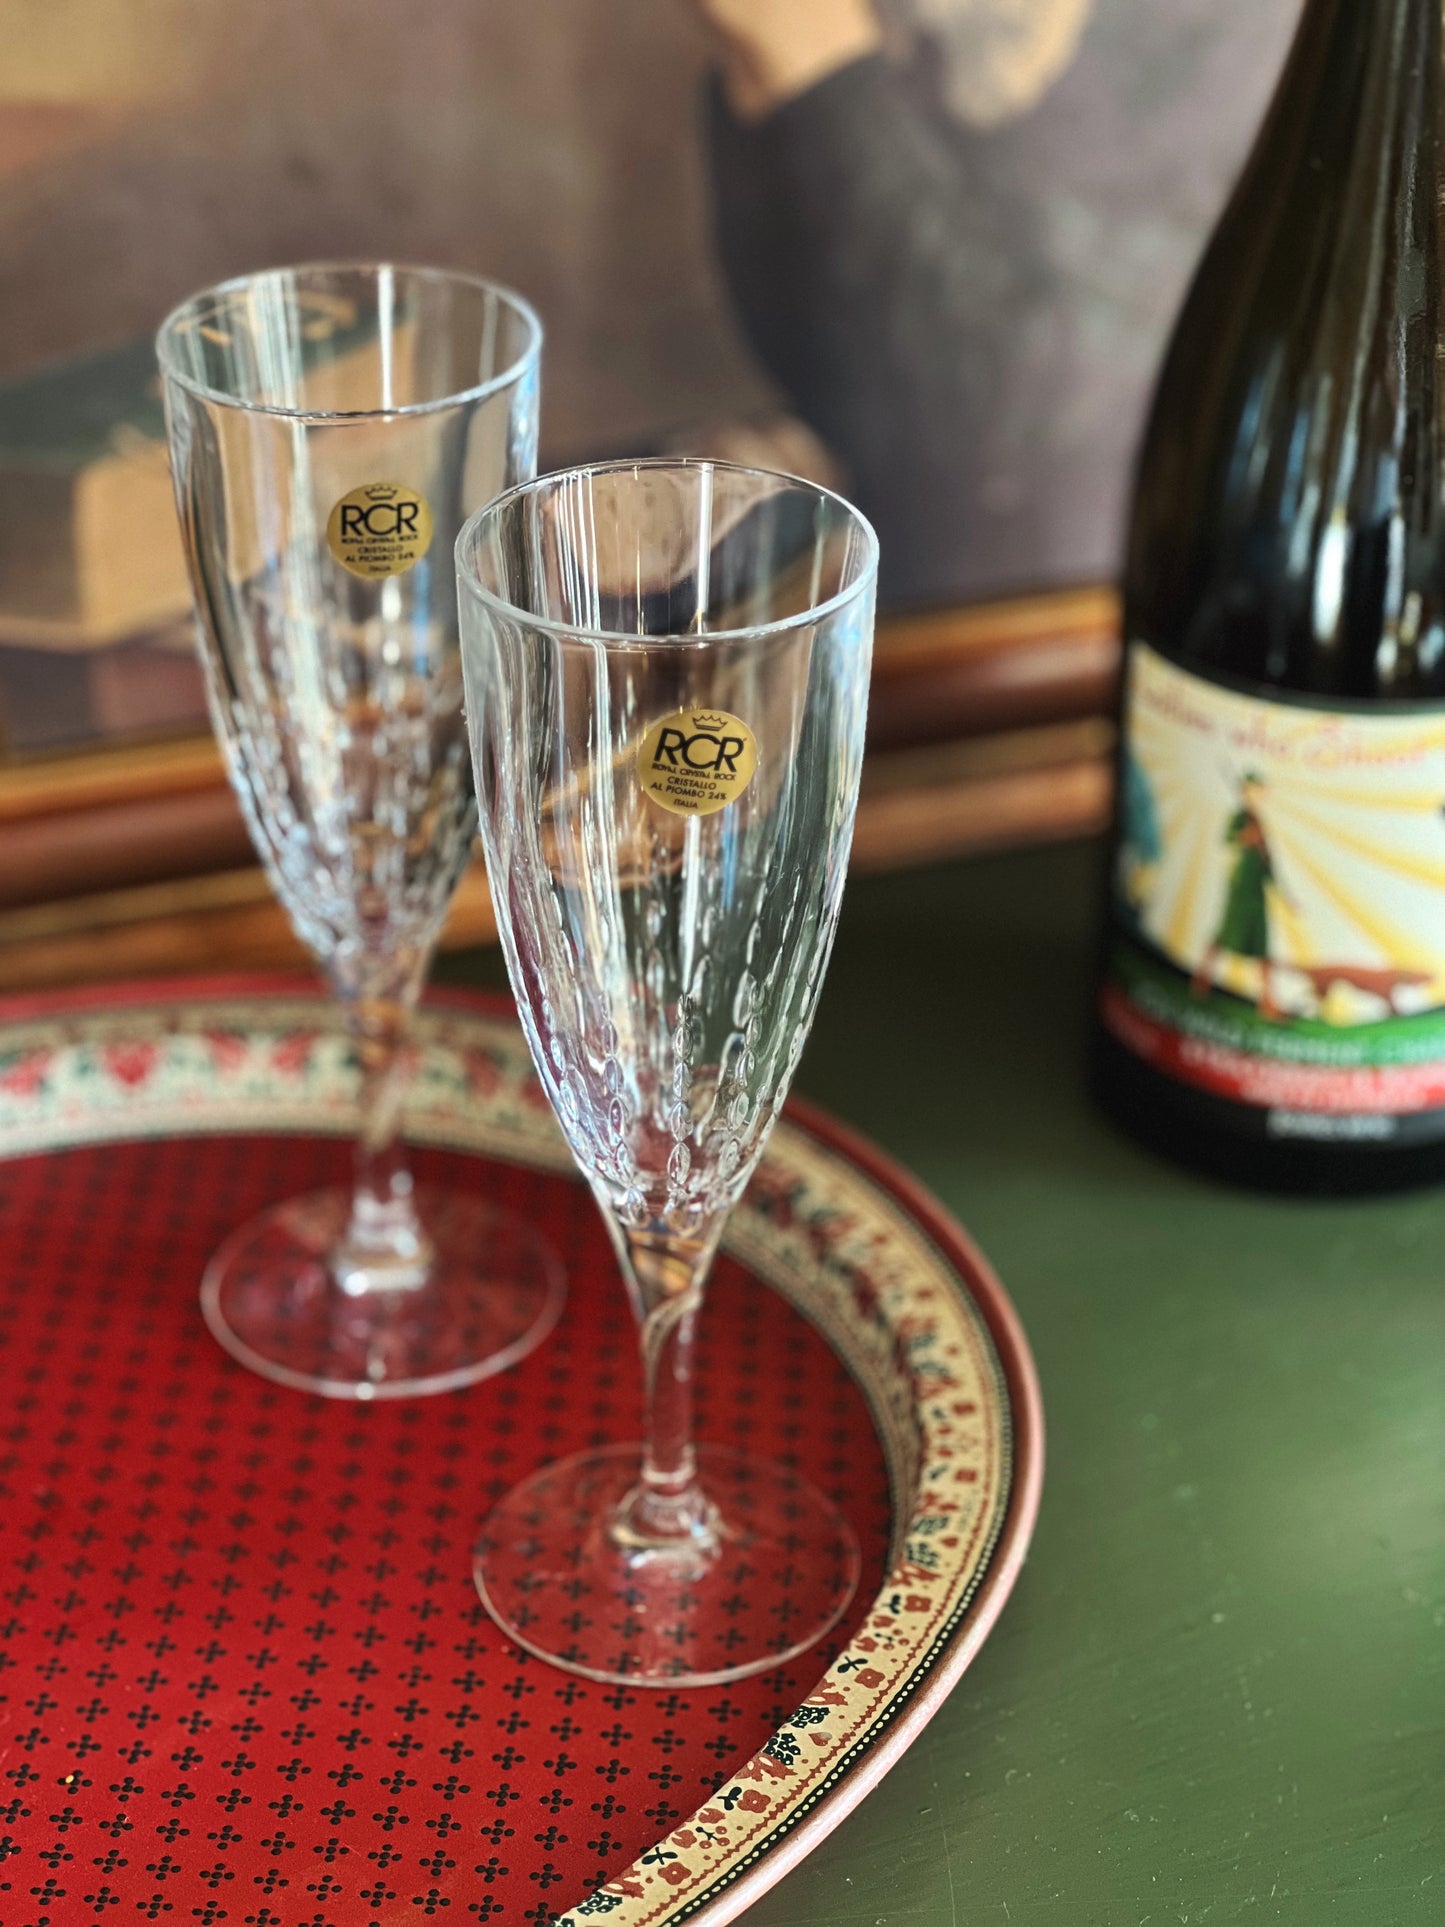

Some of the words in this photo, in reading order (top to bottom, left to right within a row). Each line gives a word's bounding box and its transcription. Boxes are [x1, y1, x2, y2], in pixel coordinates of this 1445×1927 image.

[341, 502, 418, 536] RCR
[358, 545, 403, 553] CRISTALLO
[359, 554, 395, 562] PIOMBO
[654, 728, 744, 772] RCR
[652, 763, 677, 774] ROYAL
[680, 768, 710, 779] CRYSTAL
[714, 773, 736, 781] ROCK
[650, 782, 663, 791] AL
[665, 785, 705, 798] PIOMBO
[708, 791, 727, 800] 24%
[667, 776, 717, 790] CRISTALLO
[674, 798, 698, 808] ITALIA
